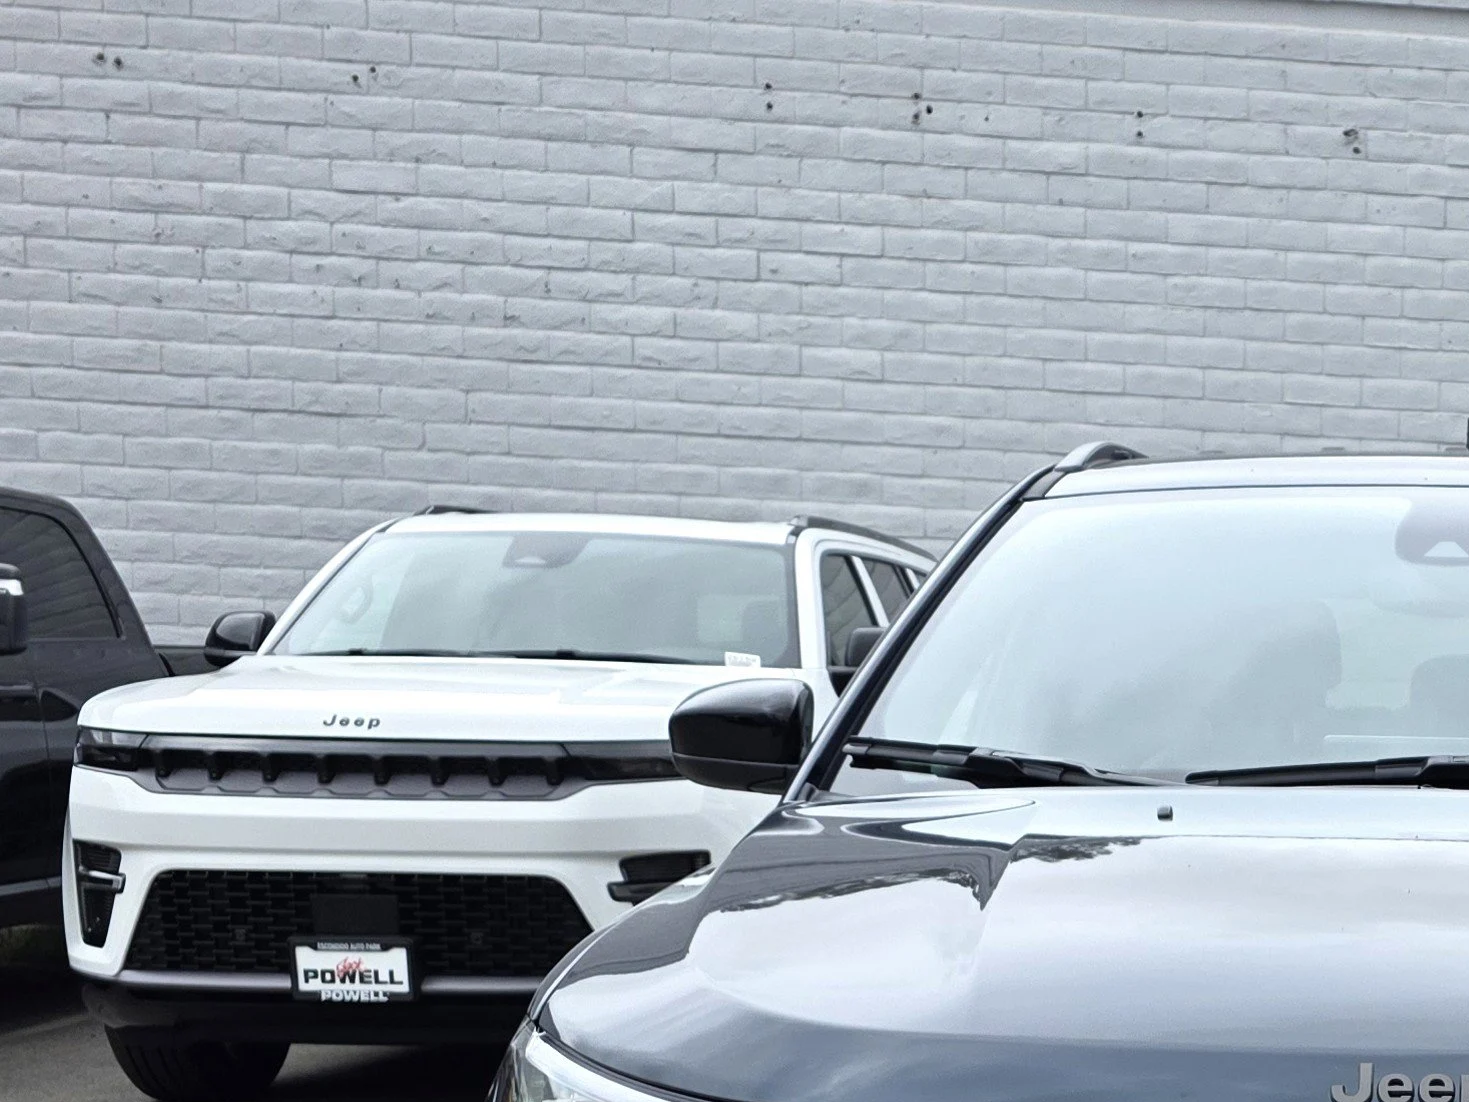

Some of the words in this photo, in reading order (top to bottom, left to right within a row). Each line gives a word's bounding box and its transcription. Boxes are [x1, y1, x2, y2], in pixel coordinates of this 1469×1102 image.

[323, 714, 380, 730] Jeep
[303, 968, 404, 985] POWELL
[320, 989, 389, 1003] POWELL
